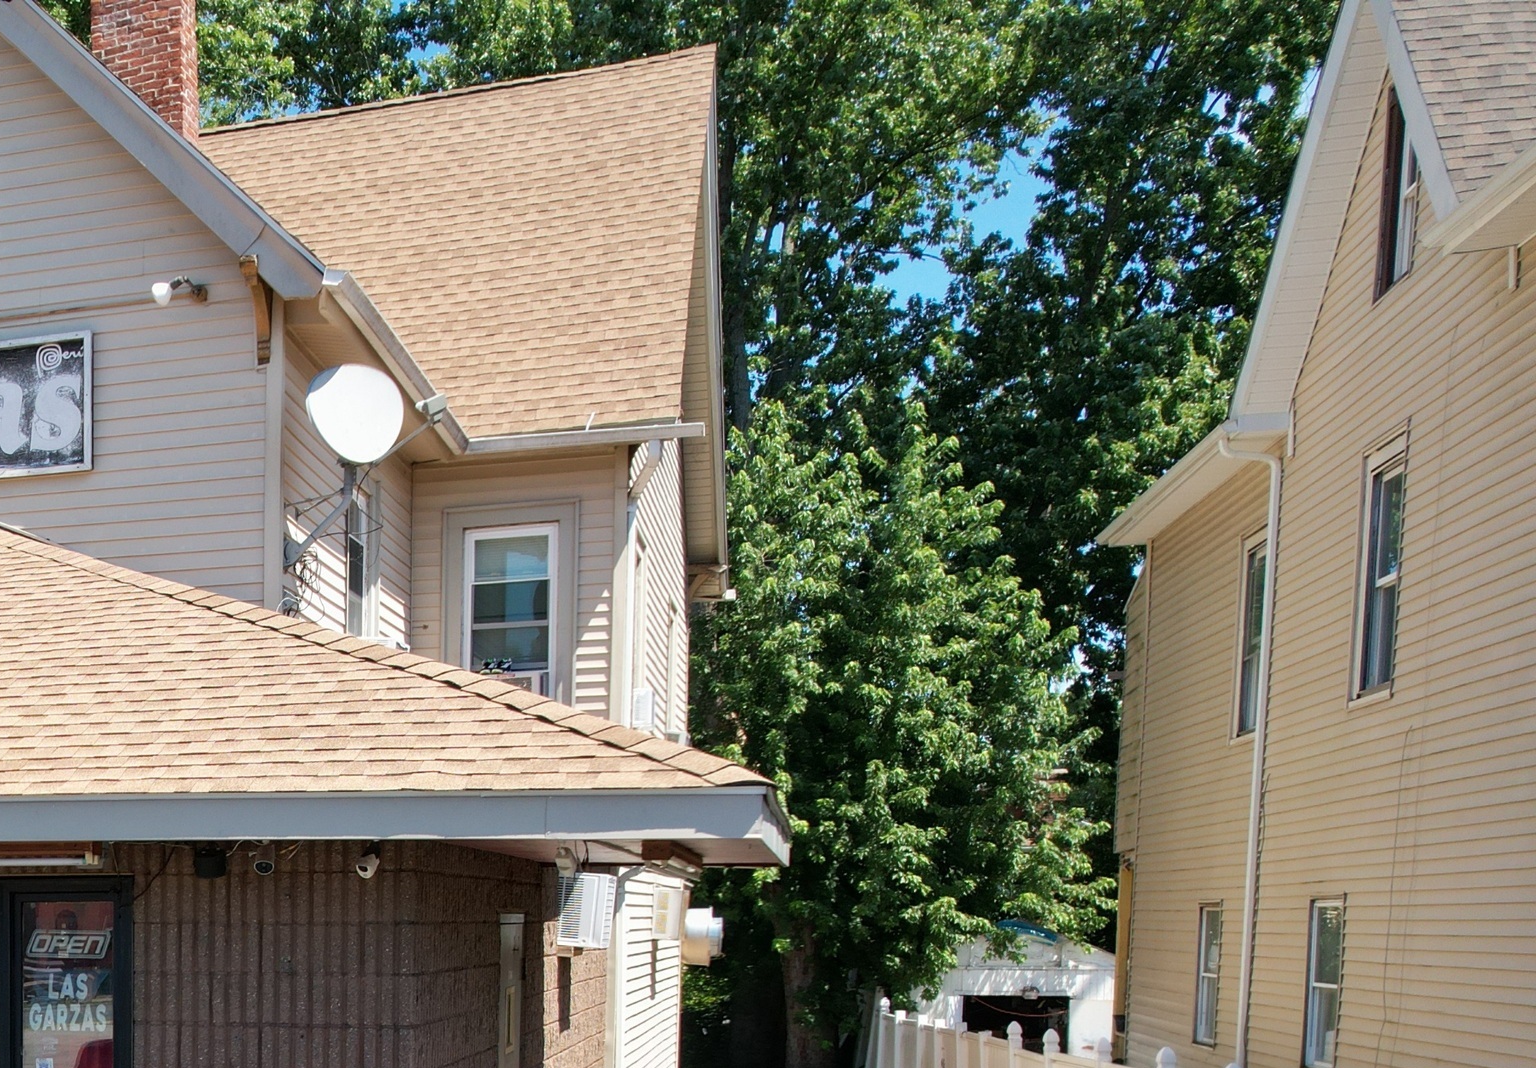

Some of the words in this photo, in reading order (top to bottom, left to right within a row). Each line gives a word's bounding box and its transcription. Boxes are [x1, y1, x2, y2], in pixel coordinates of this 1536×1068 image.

[31, 934, 105, 954] OPEN
[48, 973, 88, 1000] LAS
[29, 1003, 106, 1032] GARZAS
